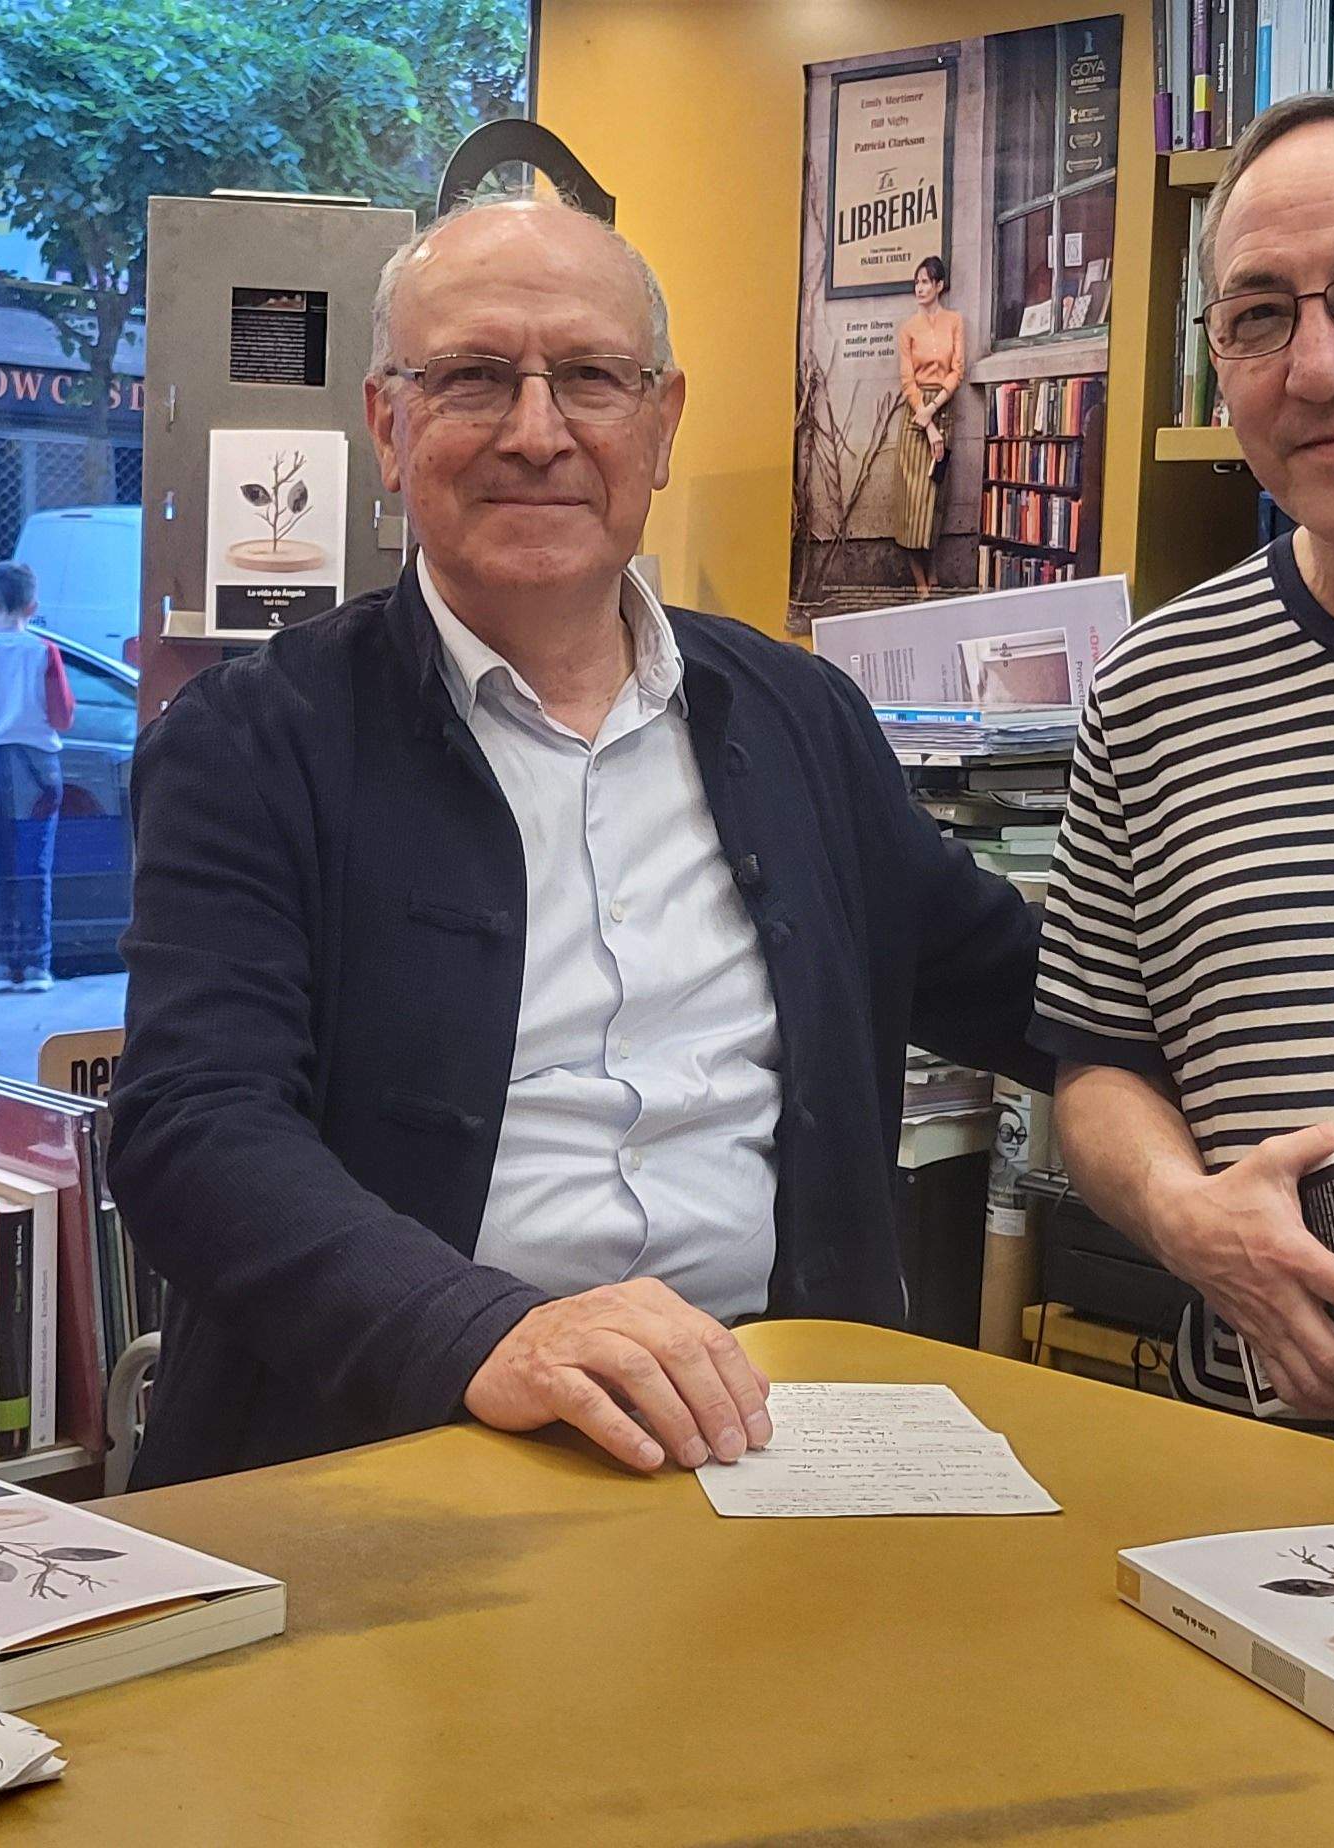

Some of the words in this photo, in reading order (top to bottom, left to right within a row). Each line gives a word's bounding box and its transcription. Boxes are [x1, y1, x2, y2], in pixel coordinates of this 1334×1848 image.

[1071, 60, 1105, 77] GOYA
[886, 93, 923, 105] Mortimer
[854, 139, 885, 153] Patricia
[888, 137, 924, 149] Clarkson
[838, 177, 937, 245] LIBRERÍA
[847, 322, 867, 331] Entre
[870, 321, 893, 330] libros
[846, 336, 866, 344] nadie
[870, 334, 893, 345] puede
[844, 349, 874, 358] sentirse
[878, 348, 894, 356] solo
[1075, 661, 1086, 706] Proyecto
[1172, 1606, 1189, 1625] Ángela
[1198, 1621, 1209, 1634] vida
[1210, 1629, 1216, 1639] La
